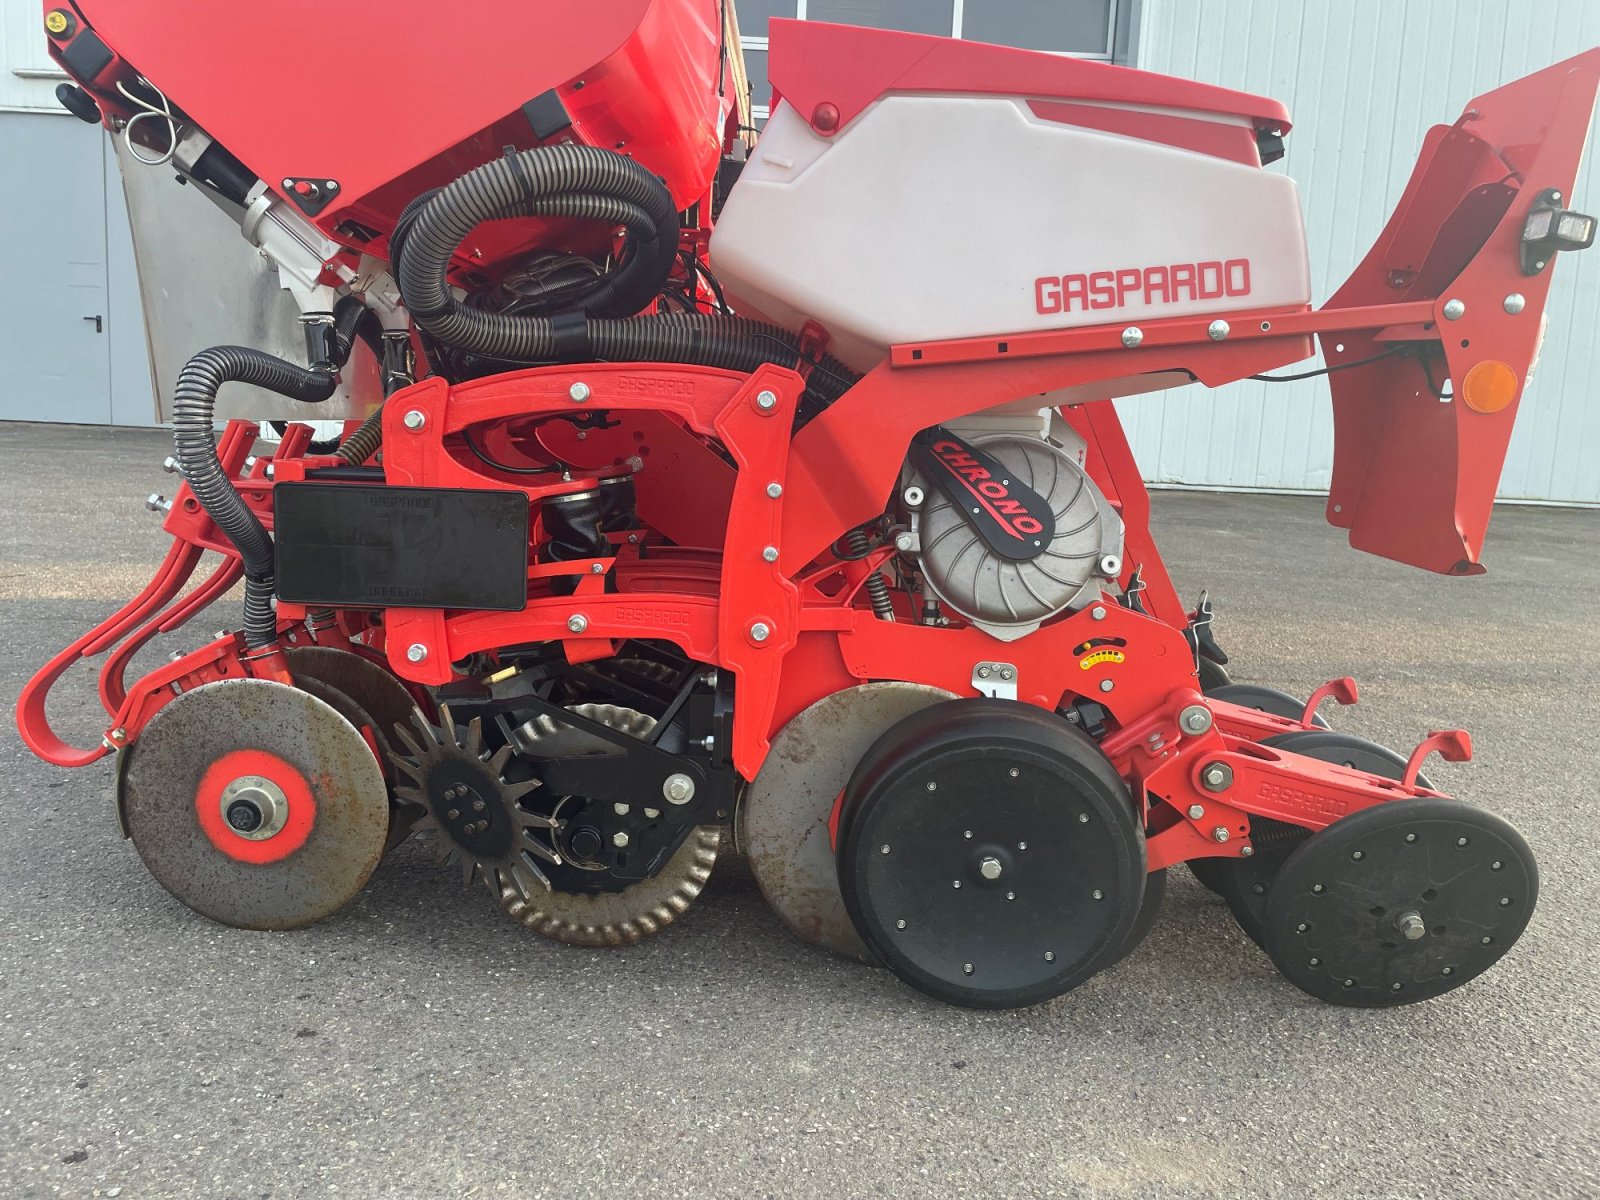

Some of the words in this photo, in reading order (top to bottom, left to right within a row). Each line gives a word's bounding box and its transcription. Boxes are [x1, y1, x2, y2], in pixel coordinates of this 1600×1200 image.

[1034, 258, 1251, 315] GASPARDO
[932, 440, 1044, 535] CHRONO
[614, 606, 690, 626] GASPARDO
[1256, 781, 1348, 818] GASPARDO
